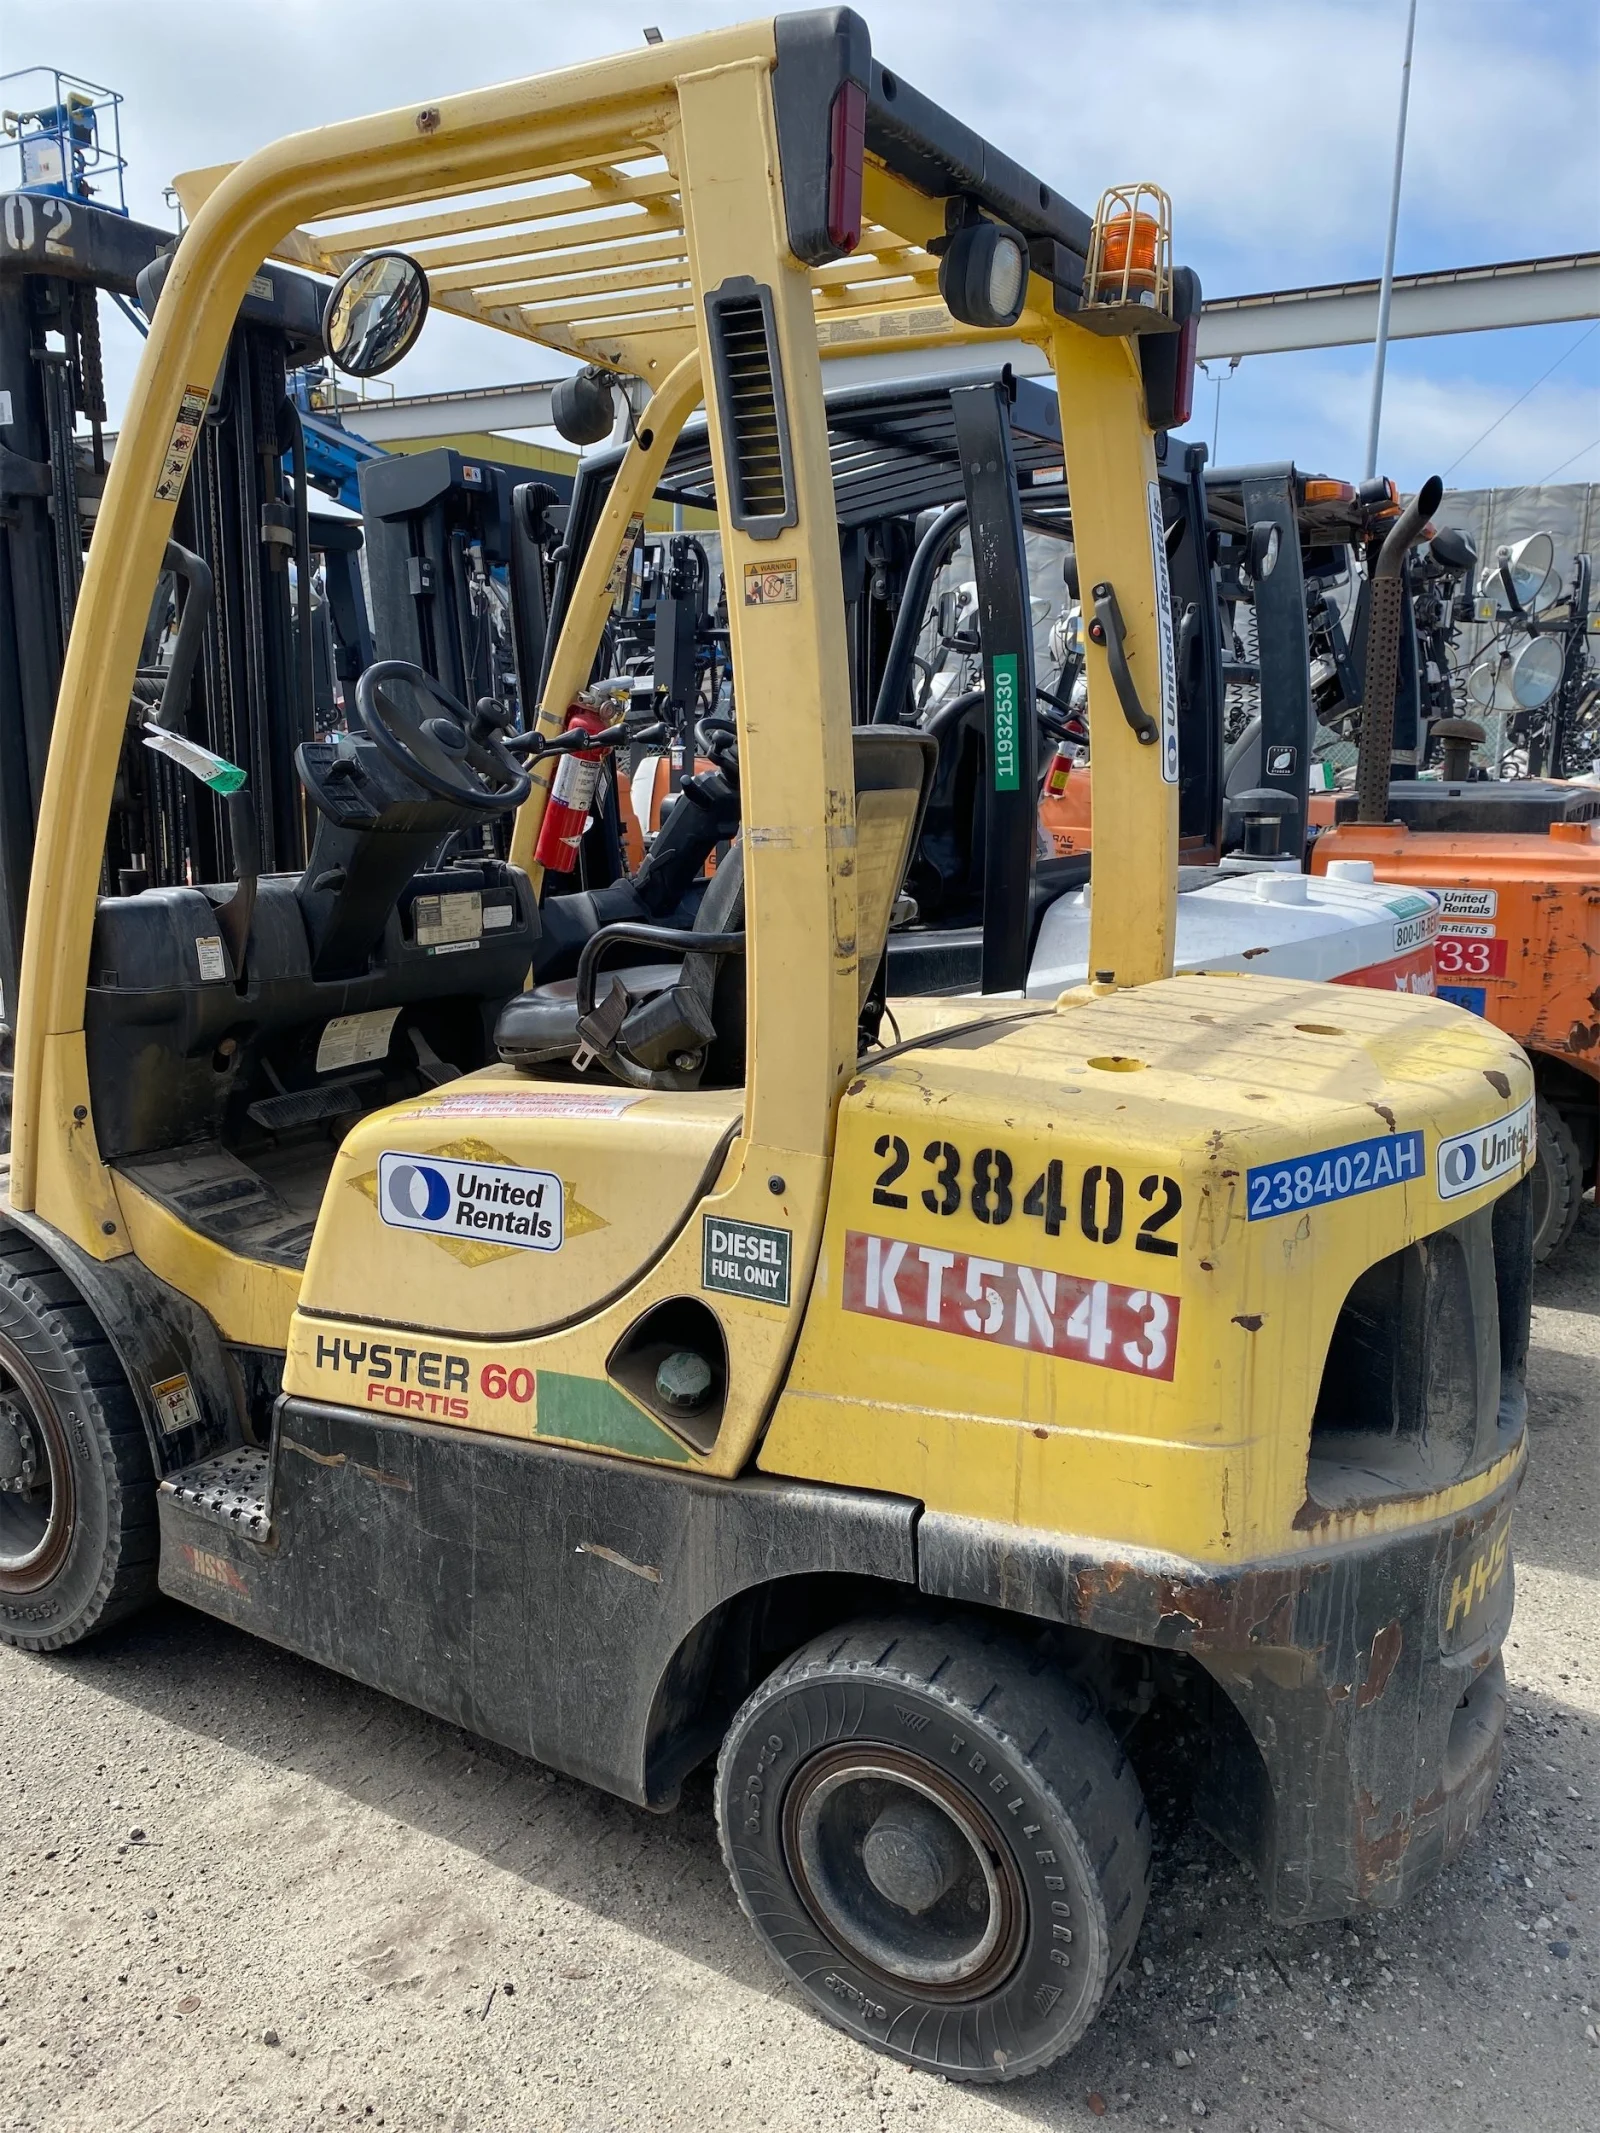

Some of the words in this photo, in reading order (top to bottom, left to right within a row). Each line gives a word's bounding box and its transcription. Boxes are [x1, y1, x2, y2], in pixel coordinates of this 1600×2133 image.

[1153, 496, 1171, 616] Rentals
[1163, 624, 1176, 727] United
[996, 672, 1014, 776] 11932530
[1442, 902, 1491, 915] Rentals
[1444, 892, 1488, 904] United
[1439, 924, 1488, 935] R-RENTS
[1433, 940, 1491, 974] 33
[1250, 1137, 1417, 1216] 238402AH
[1480, 1111, 1529, 1172] United
[456, 1173, 545, 1209] United
[872, 1134, 1183, 1258] 238402
[455, 1201, 552, 1239] Rentals
[711, 1229, 782, 1266] DIESEL
[711, 1258, 742, 1281] FUEL
[743, 1265, 781, 1288] ONLY
[864, 1236, 1170, 1371] KT5N43
[316, 1334, 470, 1394] HYSTER
[479, 1363, 536, 1404] 60
[367, 1383, 469, 1420] FORTIS
[949, 1733, 1074, 1968] TRELLEBORG
